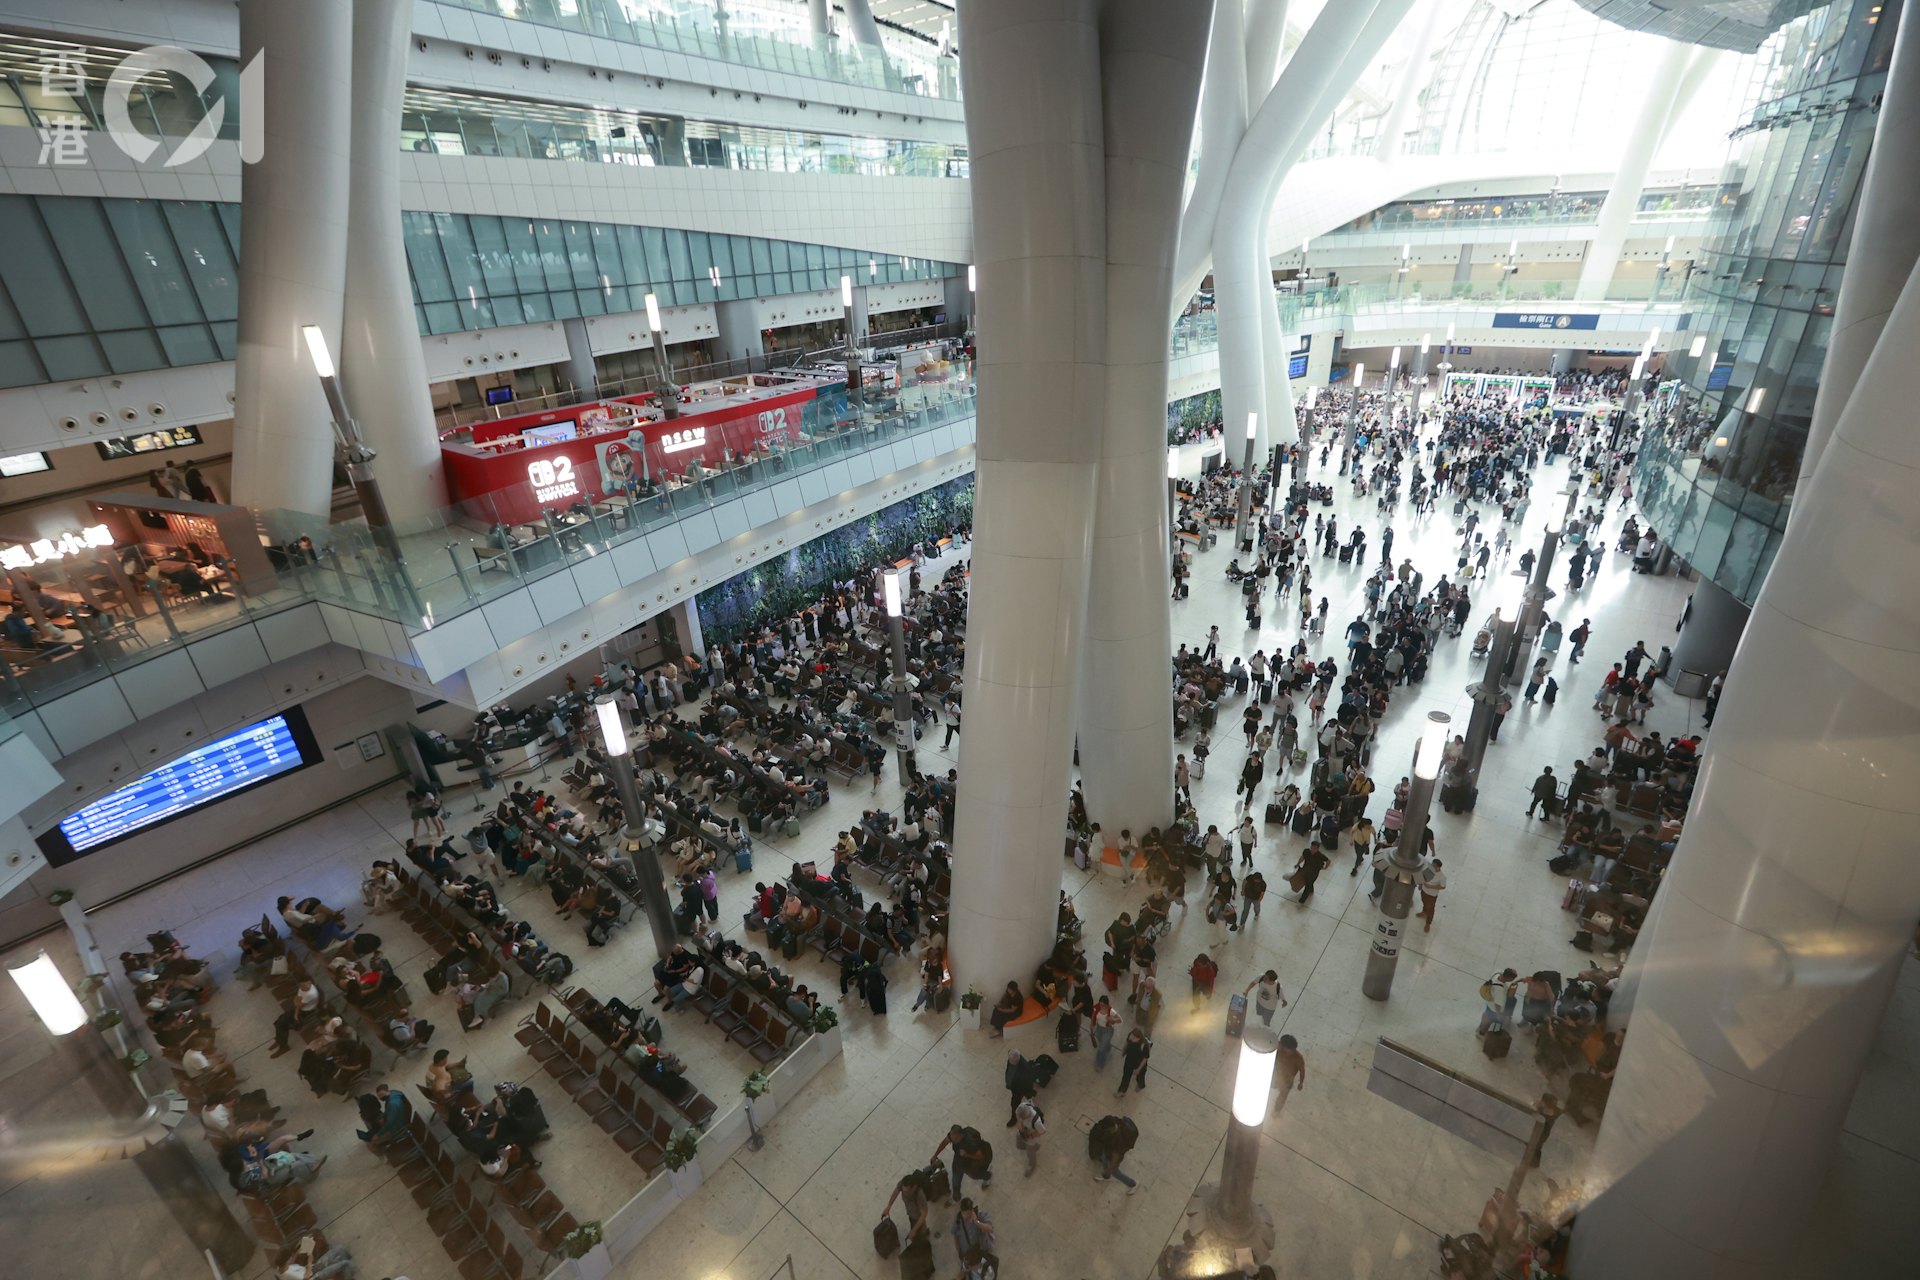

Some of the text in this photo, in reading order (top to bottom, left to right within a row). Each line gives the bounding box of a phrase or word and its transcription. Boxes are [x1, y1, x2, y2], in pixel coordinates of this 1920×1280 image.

[774, 408, 787, 430] 2
[552, 456, 576, 483] 2
[537, 486, 580, 503] SWITCH
